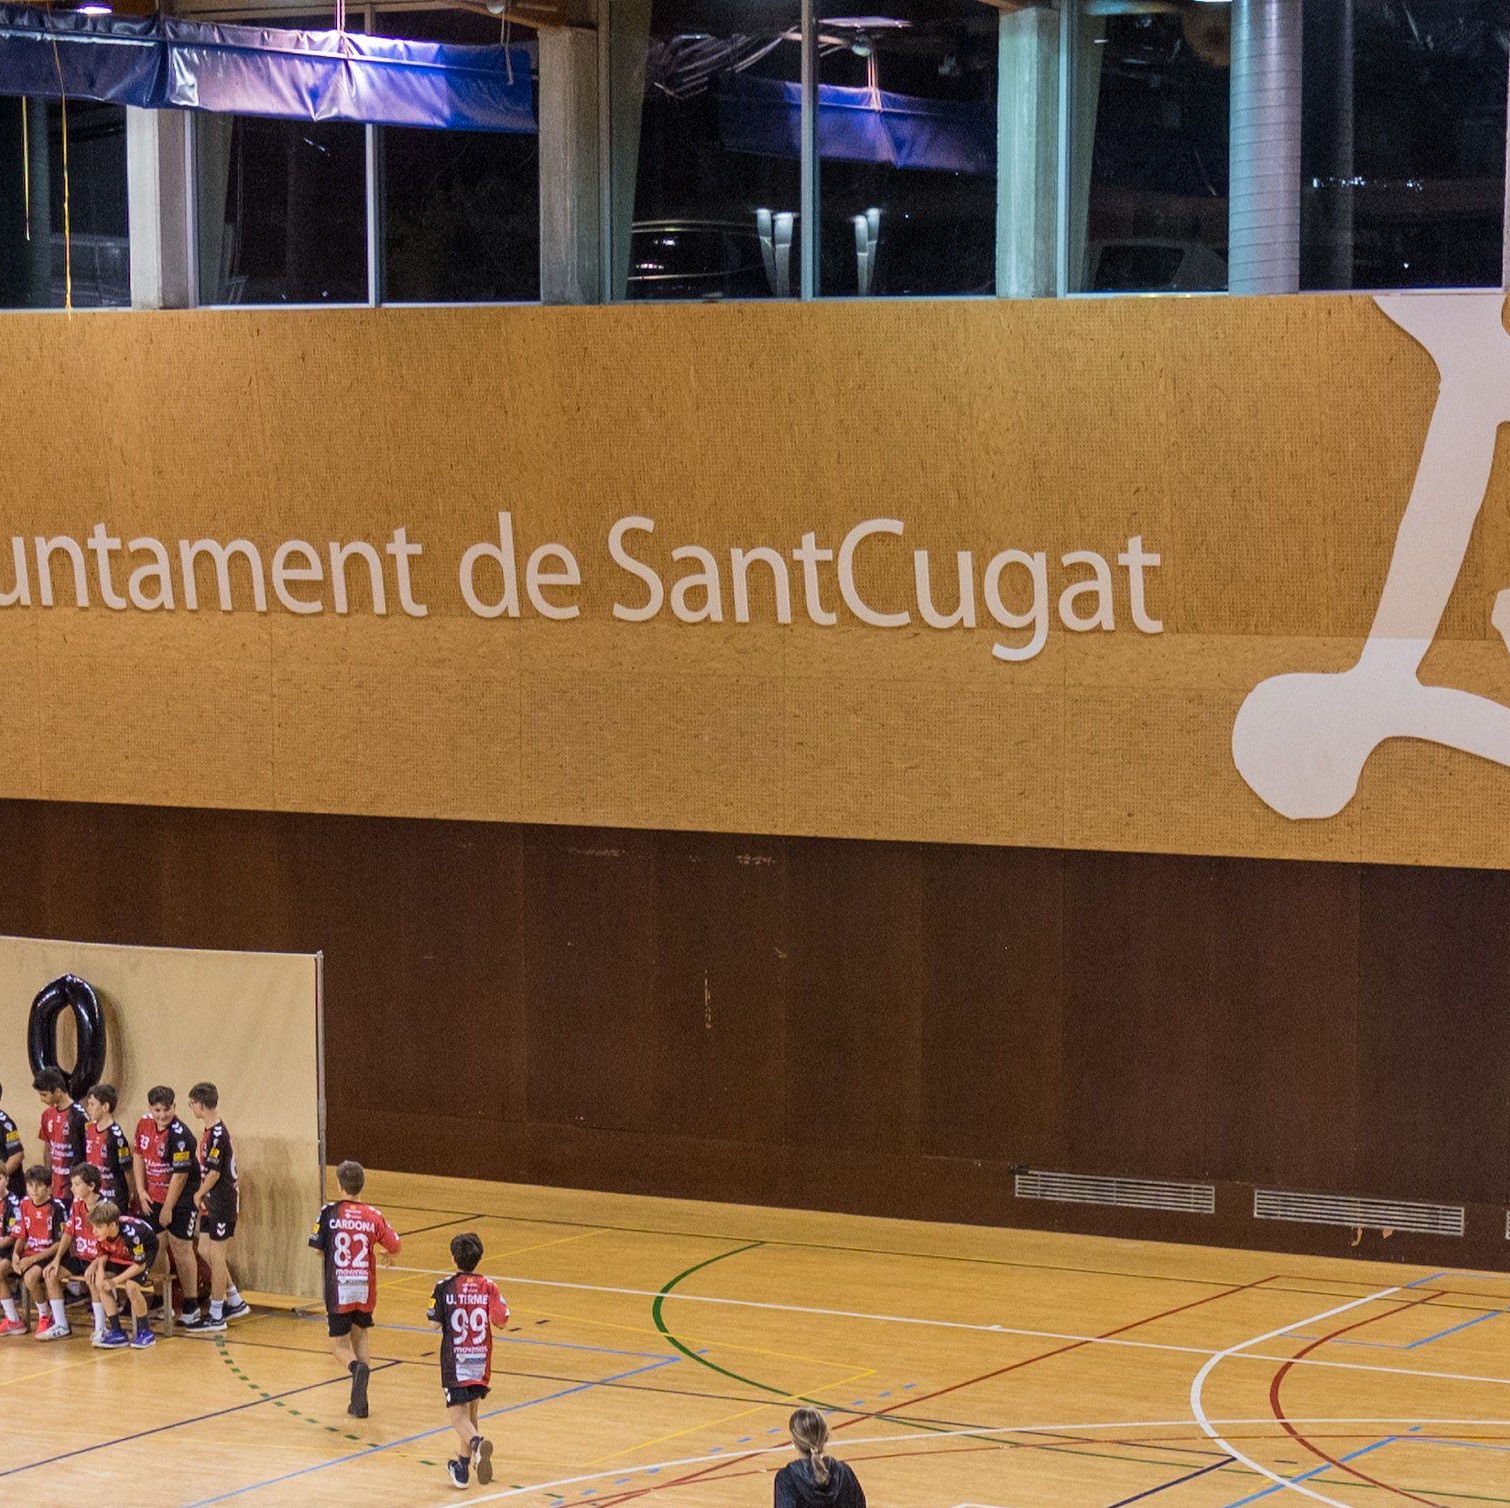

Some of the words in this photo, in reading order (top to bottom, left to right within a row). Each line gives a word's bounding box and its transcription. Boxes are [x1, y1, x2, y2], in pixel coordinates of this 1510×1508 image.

[459, 512, 581, 620] de
[608, 516, 1163, 661] SantCugat
[329, 1218, 375, 1232] CARDONA
[334, 1232, 369, 1268] 82
[451, 1307, 488, 1345] 99
